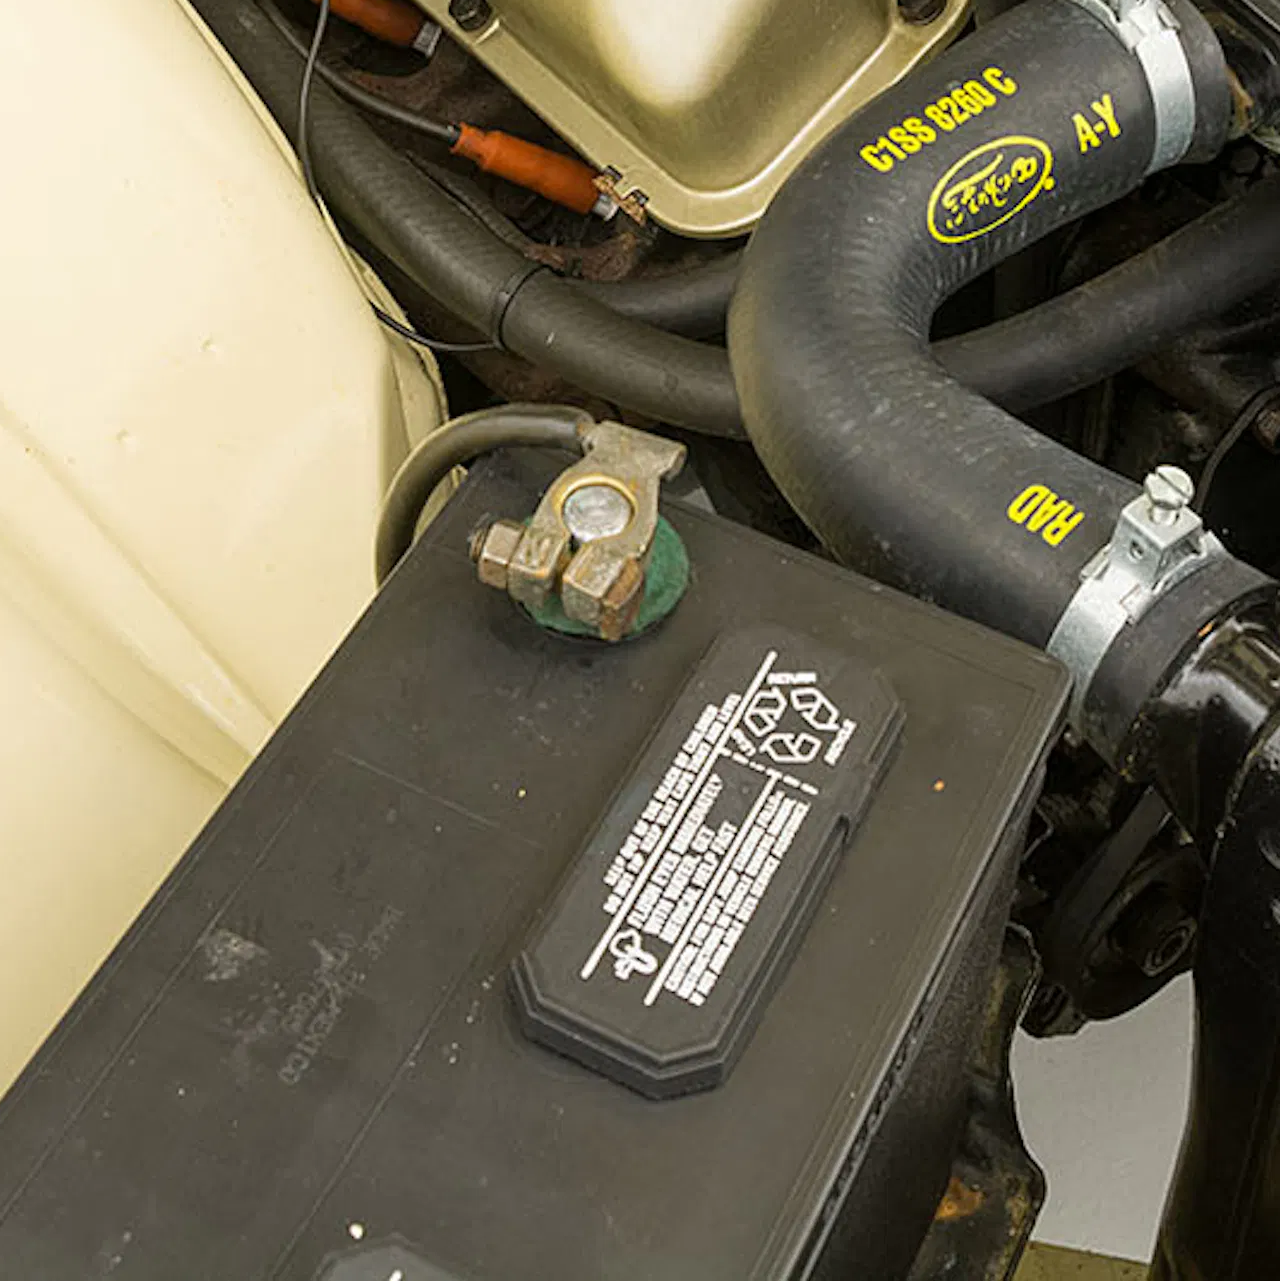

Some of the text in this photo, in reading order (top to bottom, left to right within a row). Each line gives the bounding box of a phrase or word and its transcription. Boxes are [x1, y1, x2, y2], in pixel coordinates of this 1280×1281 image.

[859, 116, 937, 173] C1SS
[982, 67, 1019, 97] C
[1073, 94, 1120, 152] A-Y
[1007, 483, 1085, 548] RAD
[691, 851, 719, 888] HELP
[710, 820, 737, 855] FAST
